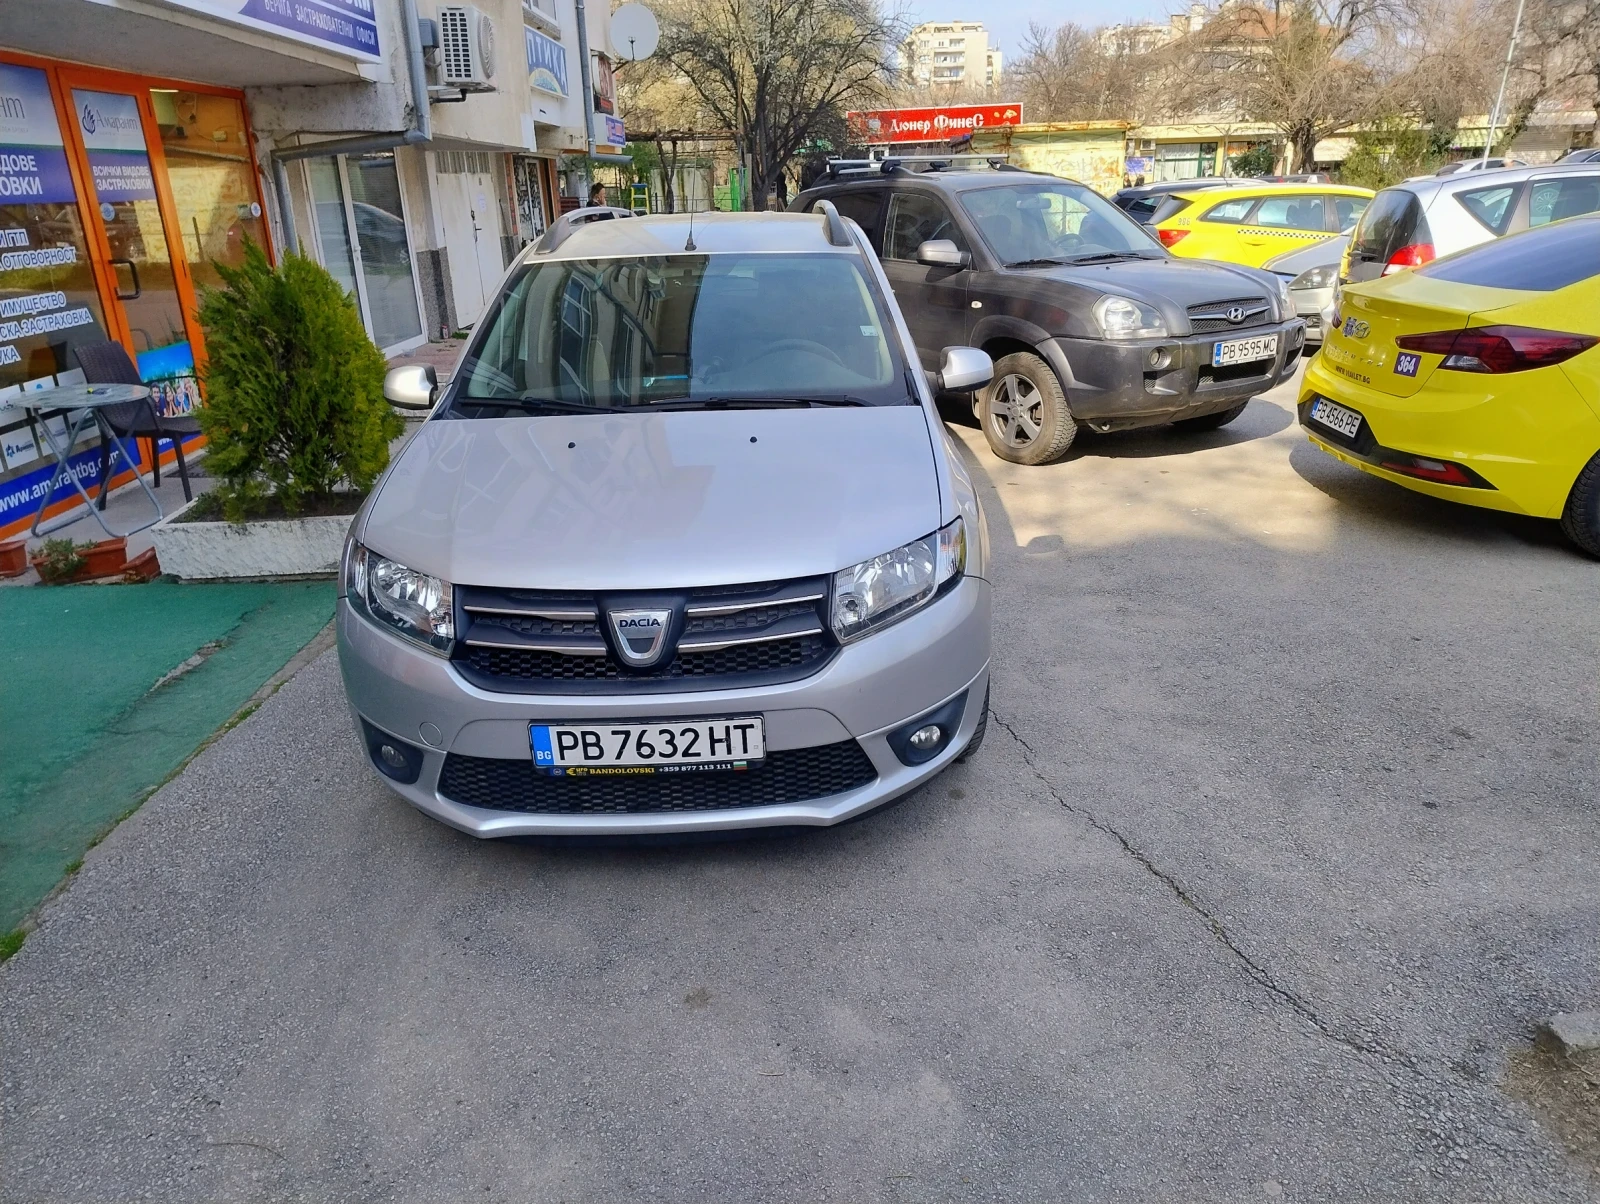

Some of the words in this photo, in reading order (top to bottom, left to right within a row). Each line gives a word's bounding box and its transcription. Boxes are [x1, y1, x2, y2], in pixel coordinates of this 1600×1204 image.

[295, 4, 354, 39] ЗАСТРАХОВАТЕЛНИ
[356, 26, 376, 46] ОФИСИ
[889, 118, 931, 135] Дюнер
[0, 154, 38, 175] ДОВЕ
[92, 165, 121, 177] ВСИЧКИ
[122, 165, 150, 177] ВИДОВЕ
[0, 176, 43, 196] ОВКИ
[96, 178, 153, 191] ЗАСТРАХОВКИ
[2, 247, 76, 270] ОТГОВОРНОСТ
[1, 292, 66, 317] ИМУЩЕСТВО
[21, 309, 92, 335] ЗАСТРАХОВКА
[1222, 344, 1236, 361] PB
[1238, 340, 1262, 358] 9595
[1262, 337, 1276, 354] MC
[1397, 355, 1416, 374] 364
[1316, 401, 1328, 420] PB
[1326, 406, 1347, 429] 4566
[1343, 414, 1359, 435] PE
[619, 617, 661, 628] DACIA
[556, 729, 605, 761] PB
[611, 727, 702, 760] 7632
[708, 723, 755, 756] HT
[537, 750, 552, 761] BG
[589, 767, 655, 775] BANDOLOVSKI
[659, 765, 680, 773] +359
